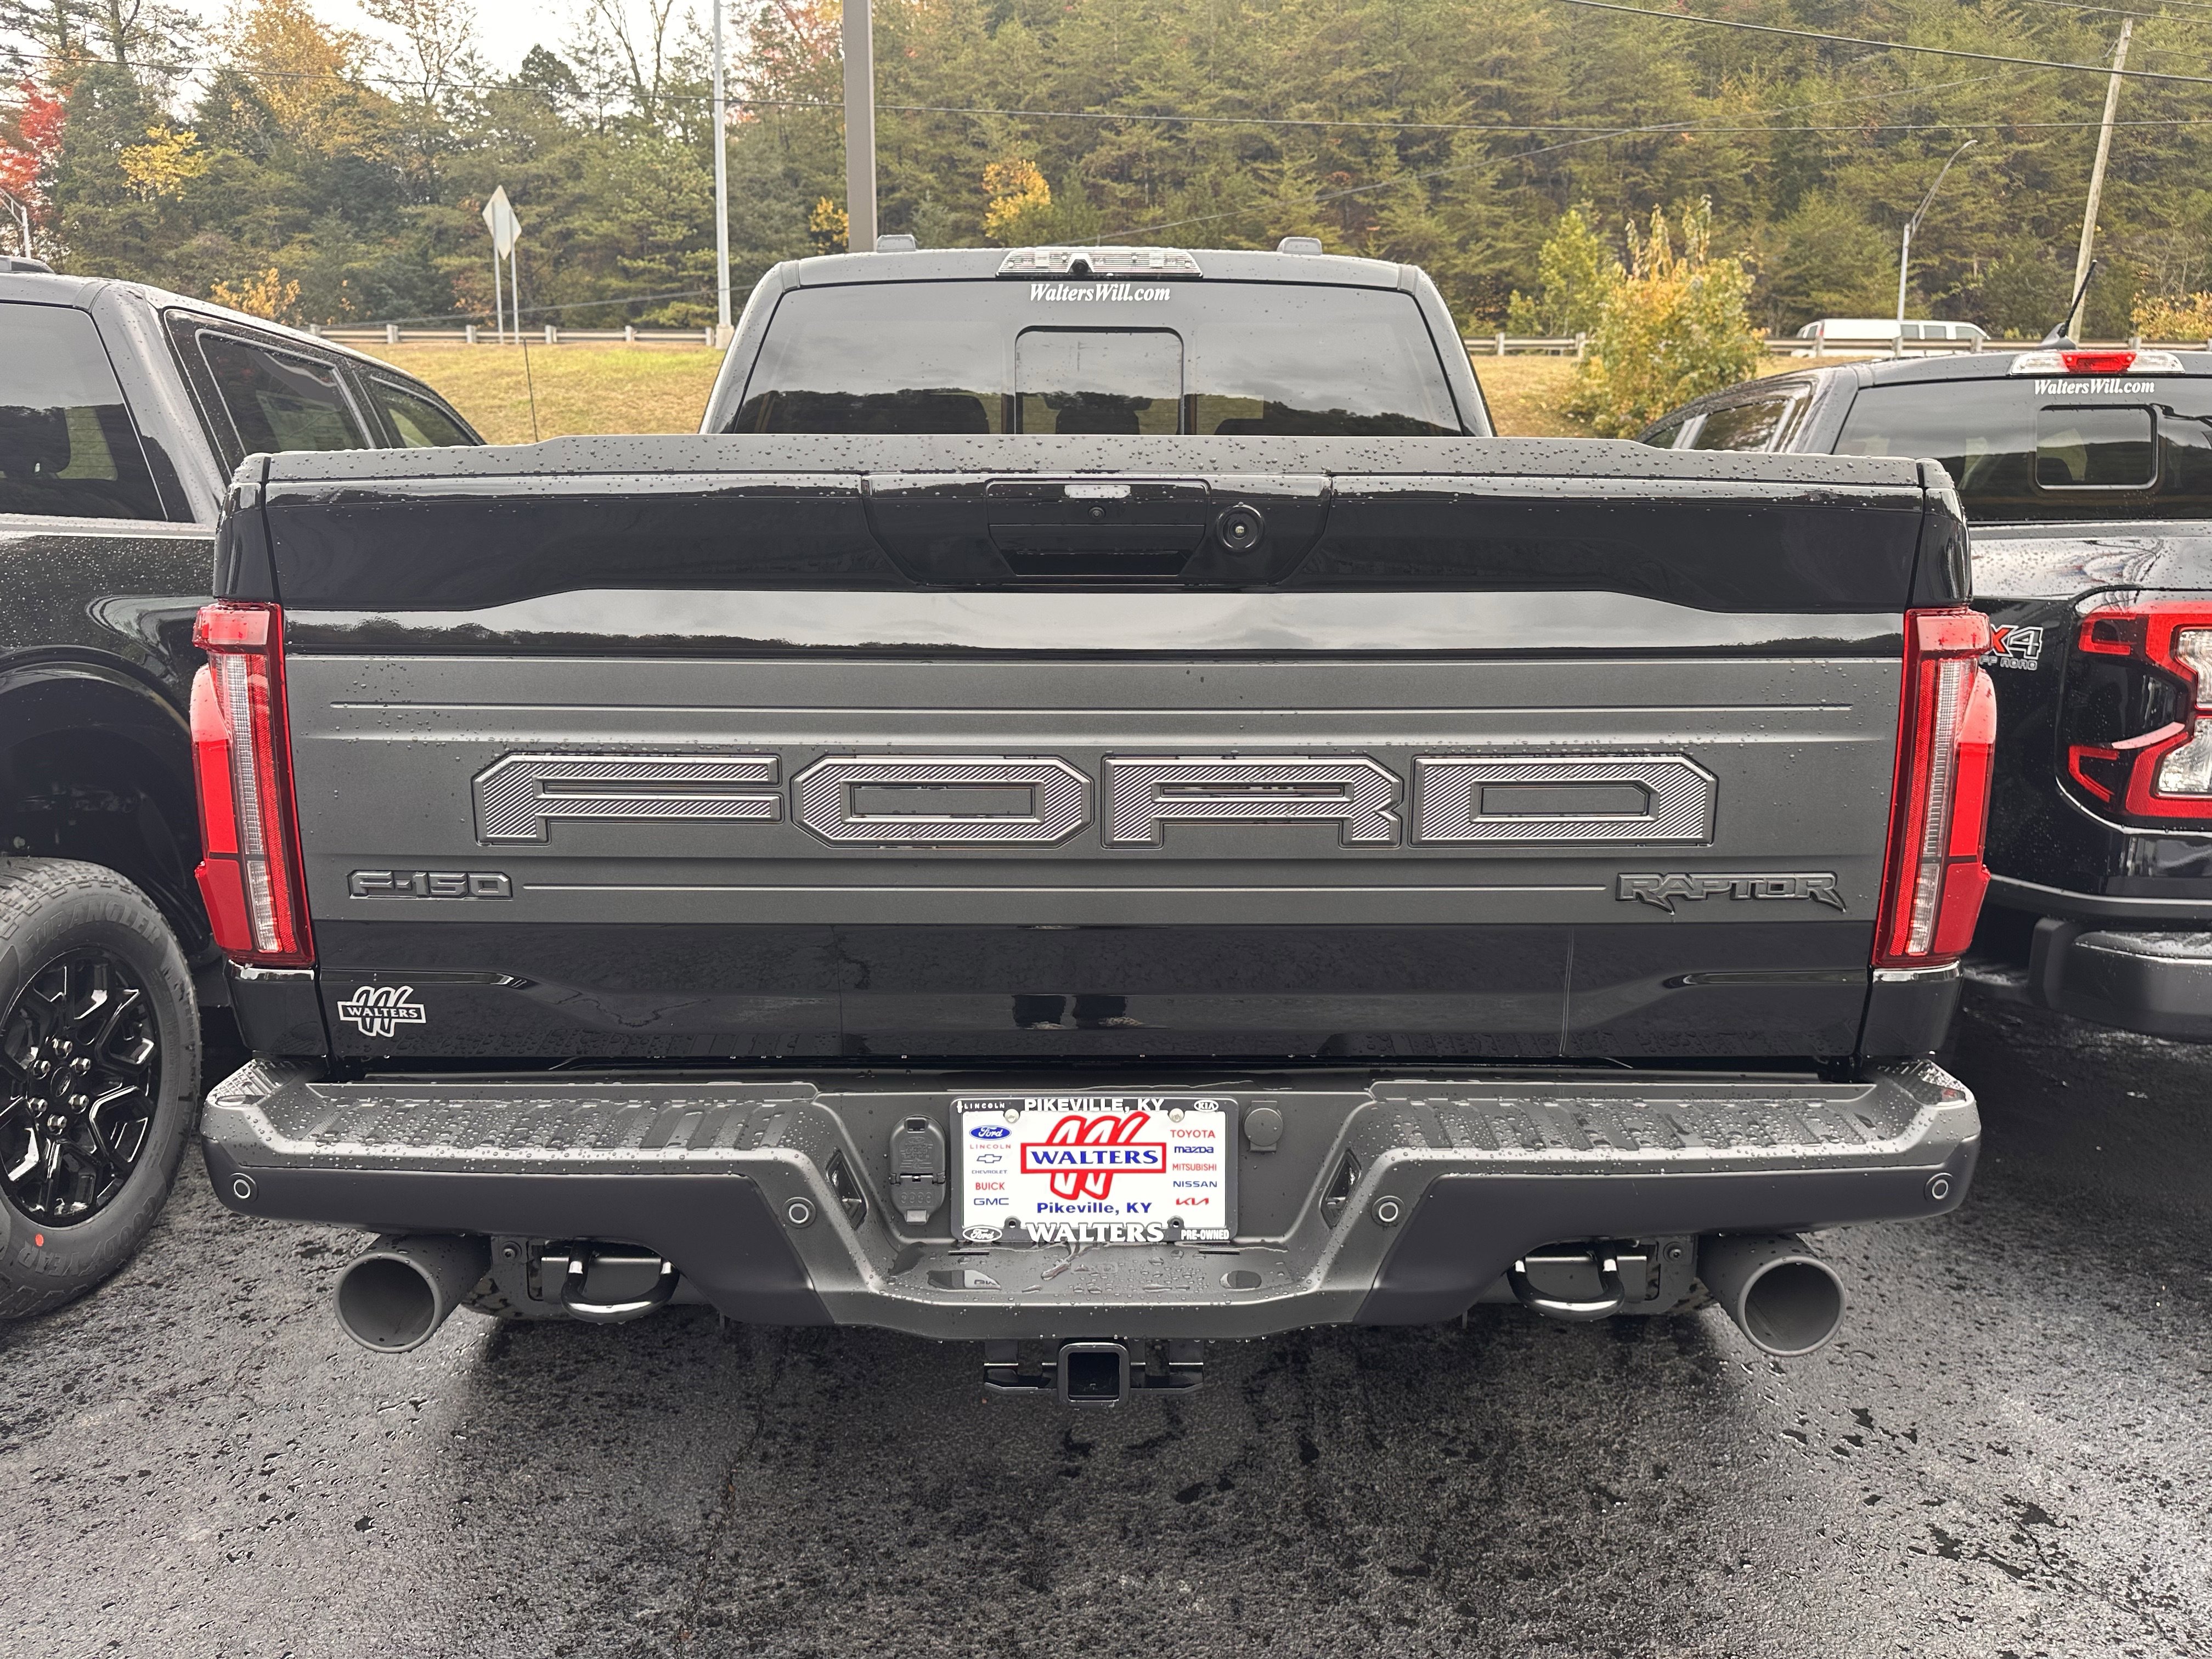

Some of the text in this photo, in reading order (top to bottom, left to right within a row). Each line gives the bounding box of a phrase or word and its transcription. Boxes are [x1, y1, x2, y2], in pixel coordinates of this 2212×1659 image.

[1030, 284, 1170, 301] WaltersWill.com
[2034, 379, 2154, 395] WaltersWill.com
[1985, 624, 2043, 660] X4
[2000, 657, 2038, 671] ROAD
[471, 751, 1719, 847] FORD
[347, 870, 513, 900] F-150
[1616, 871, 1847, 915] RAPTOR
[26, 899, 161, 956] WRANGLER
[346, 1006, 419, 1019] WALTERS
[1024, 1098, 1165, 1113] PIKEVILLE, KY
[1198, 1102, 1215, 1110] KIA
[1170, 1130, 1216, 1138] TOYOTA
[1030, 1149, 1159, 1165] WALTERS
[1172, 1163, 1217, 1171] MITSUBISHI
[975, 1182, 1006, 1190] BUICK
[973, 1198, 1009, 1206] GMC
[1037, 1202, 1153, 1215] Pikeville, KY
[1025, 1222, 1164, 1242] WALTERS
[1181, 1229, 1229, 1240] PRE-OWNED
